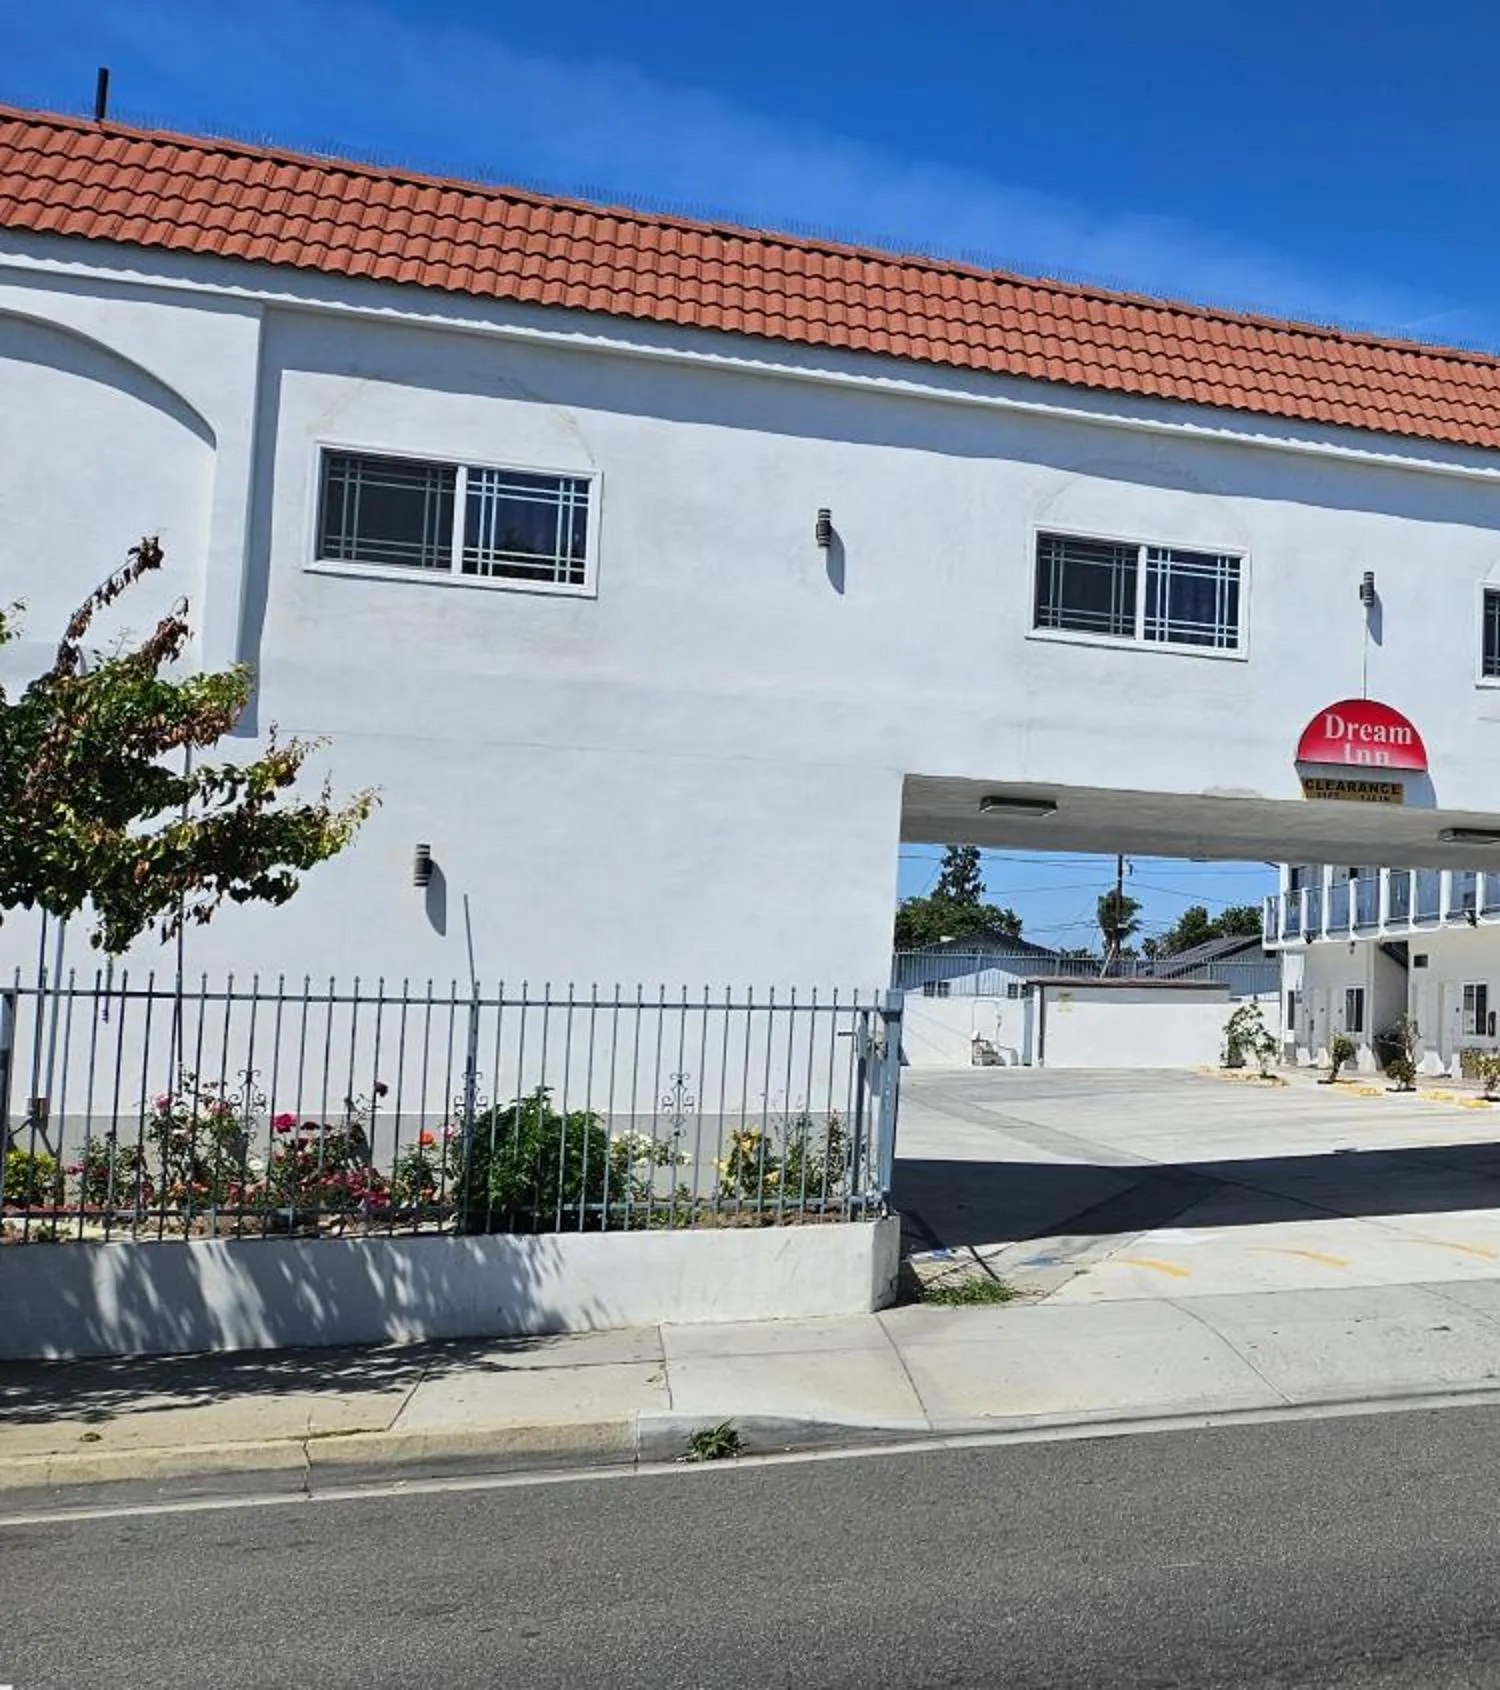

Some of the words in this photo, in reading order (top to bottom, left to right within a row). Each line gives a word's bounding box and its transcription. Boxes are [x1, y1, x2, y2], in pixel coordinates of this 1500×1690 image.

[1324, 714, 1412, 745] Dream
[1343, 743, 1390, 766] Inn
[1305, 778, 1401, 795] CLEARANCE
